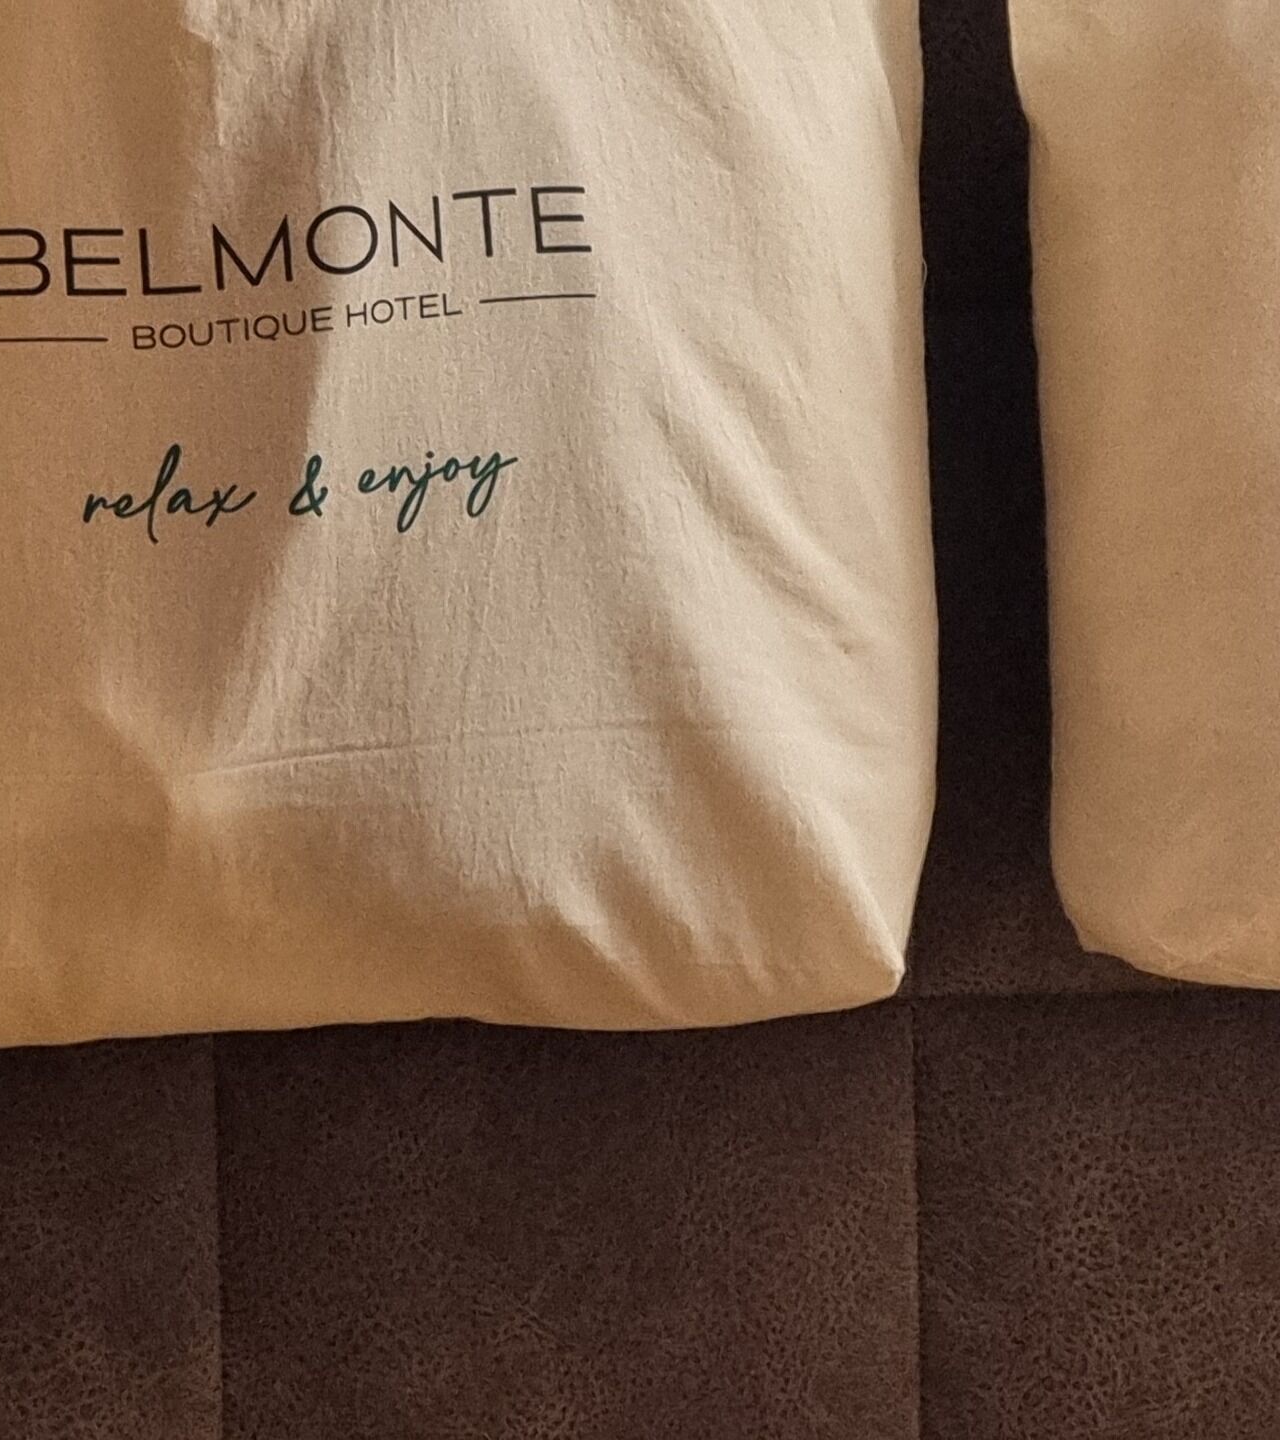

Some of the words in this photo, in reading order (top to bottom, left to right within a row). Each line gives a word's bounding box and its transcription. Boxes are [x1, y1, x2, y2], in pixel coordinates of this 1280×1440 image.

[131, 305, 334, 351] BOUTIQUE
[345, 292, 463, 328] HOTEL
[82, 443, 258, 545] relax
[287, 454, 330, 518] &
[357, 449, 520, 534] enjoy
